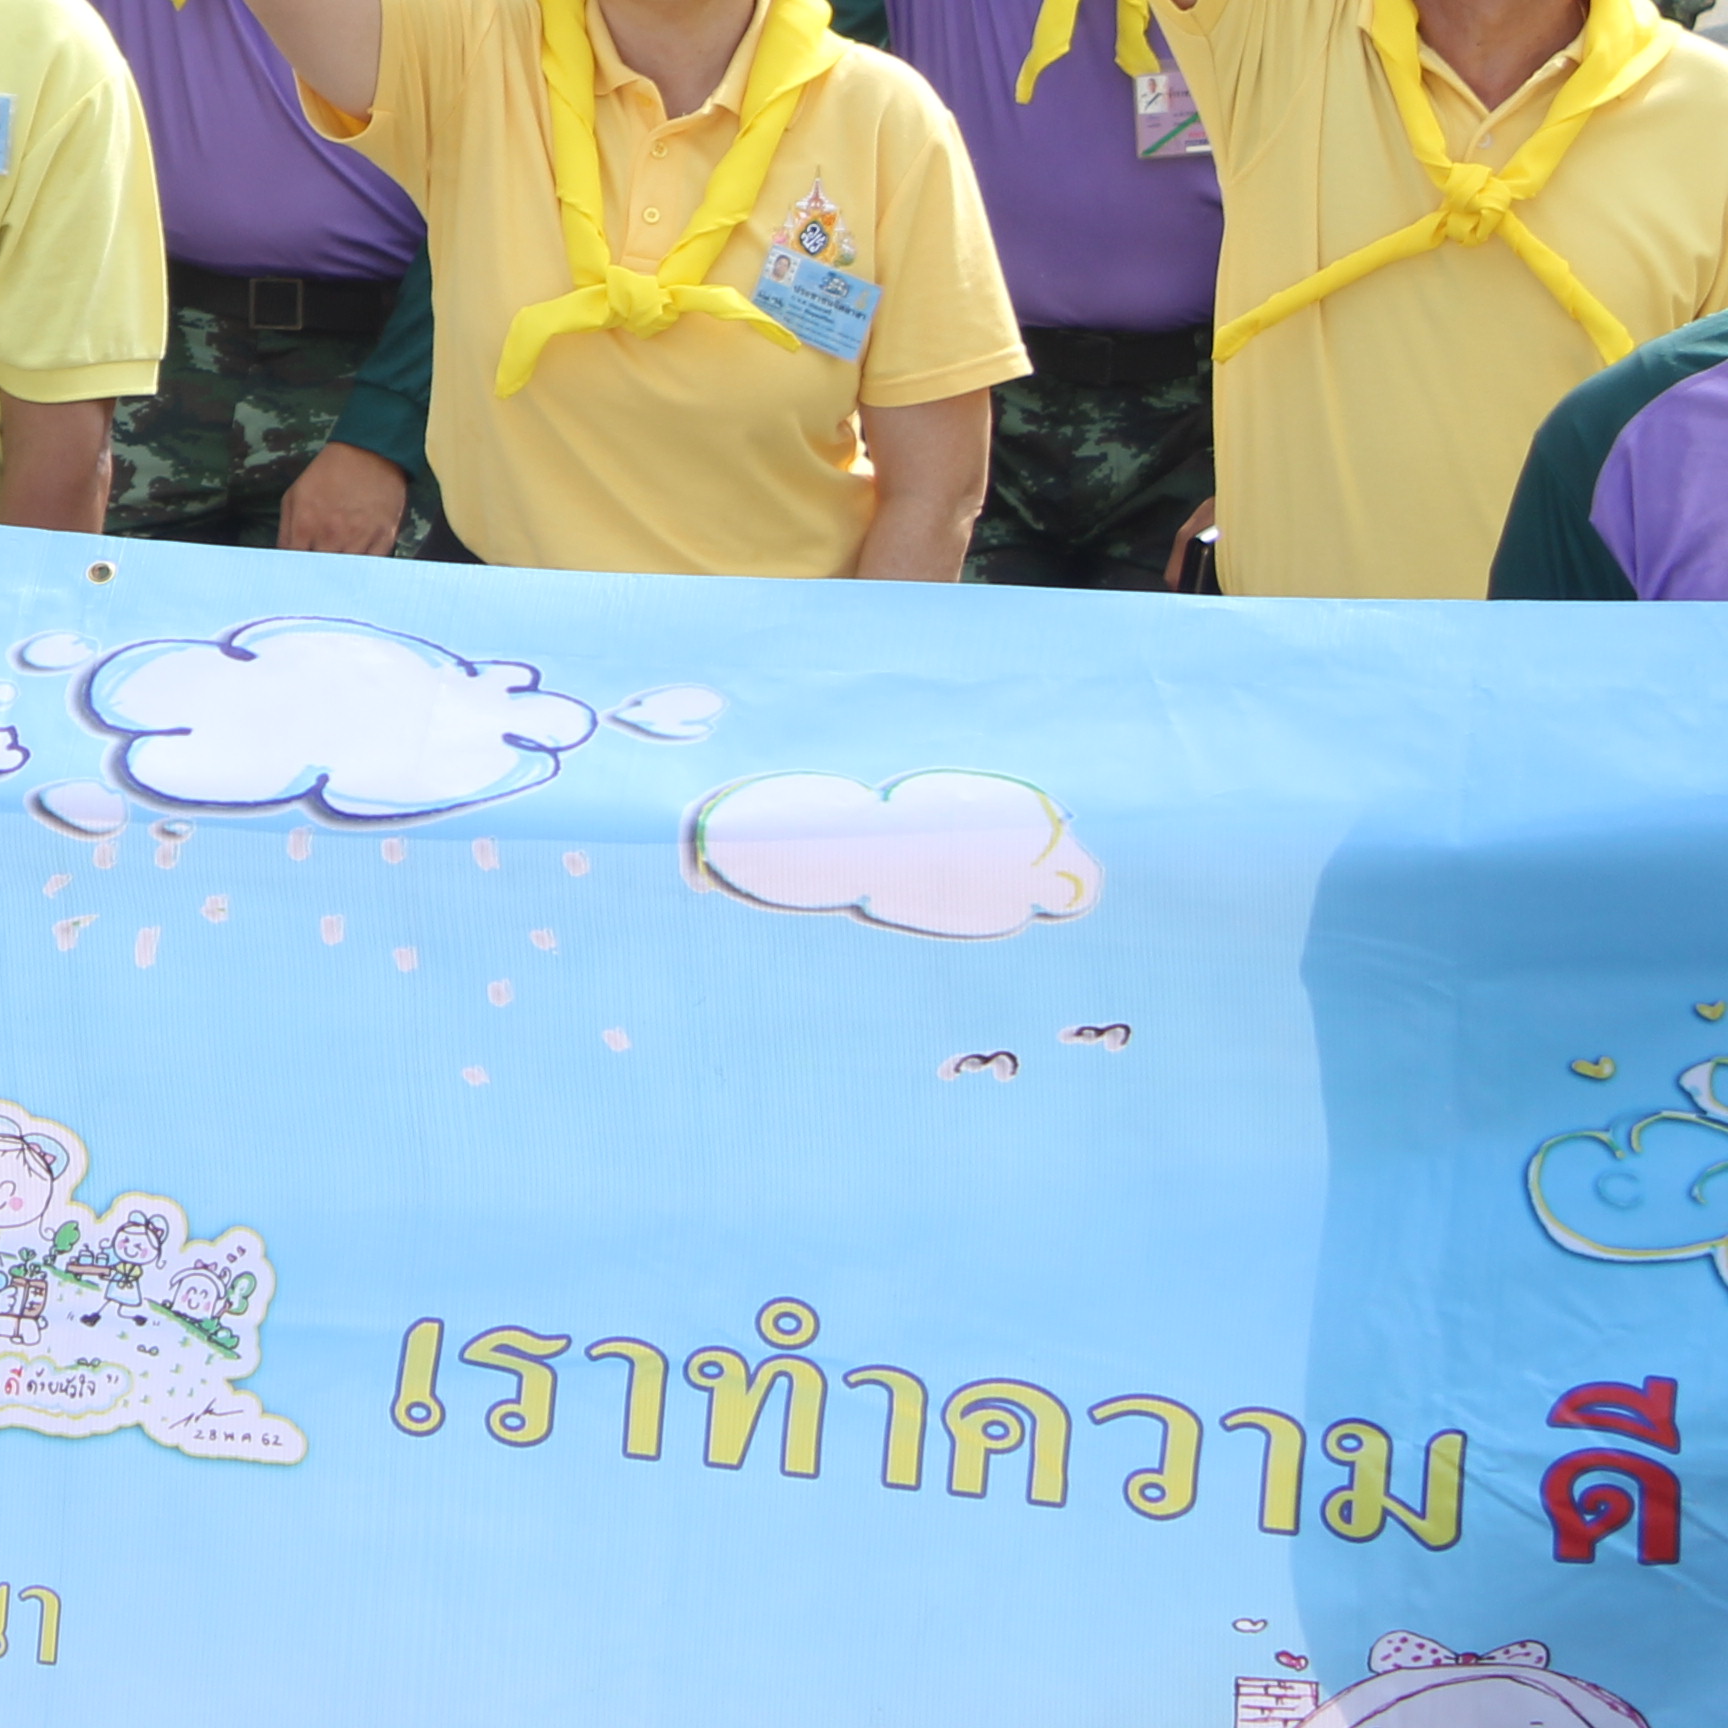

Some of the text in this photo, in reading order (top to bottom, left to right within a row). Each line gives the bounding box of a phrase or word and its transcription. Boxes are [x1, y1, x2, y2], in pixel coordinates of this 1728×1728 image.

[394, 1298, 1683, 1567] เราทำความ ดี
